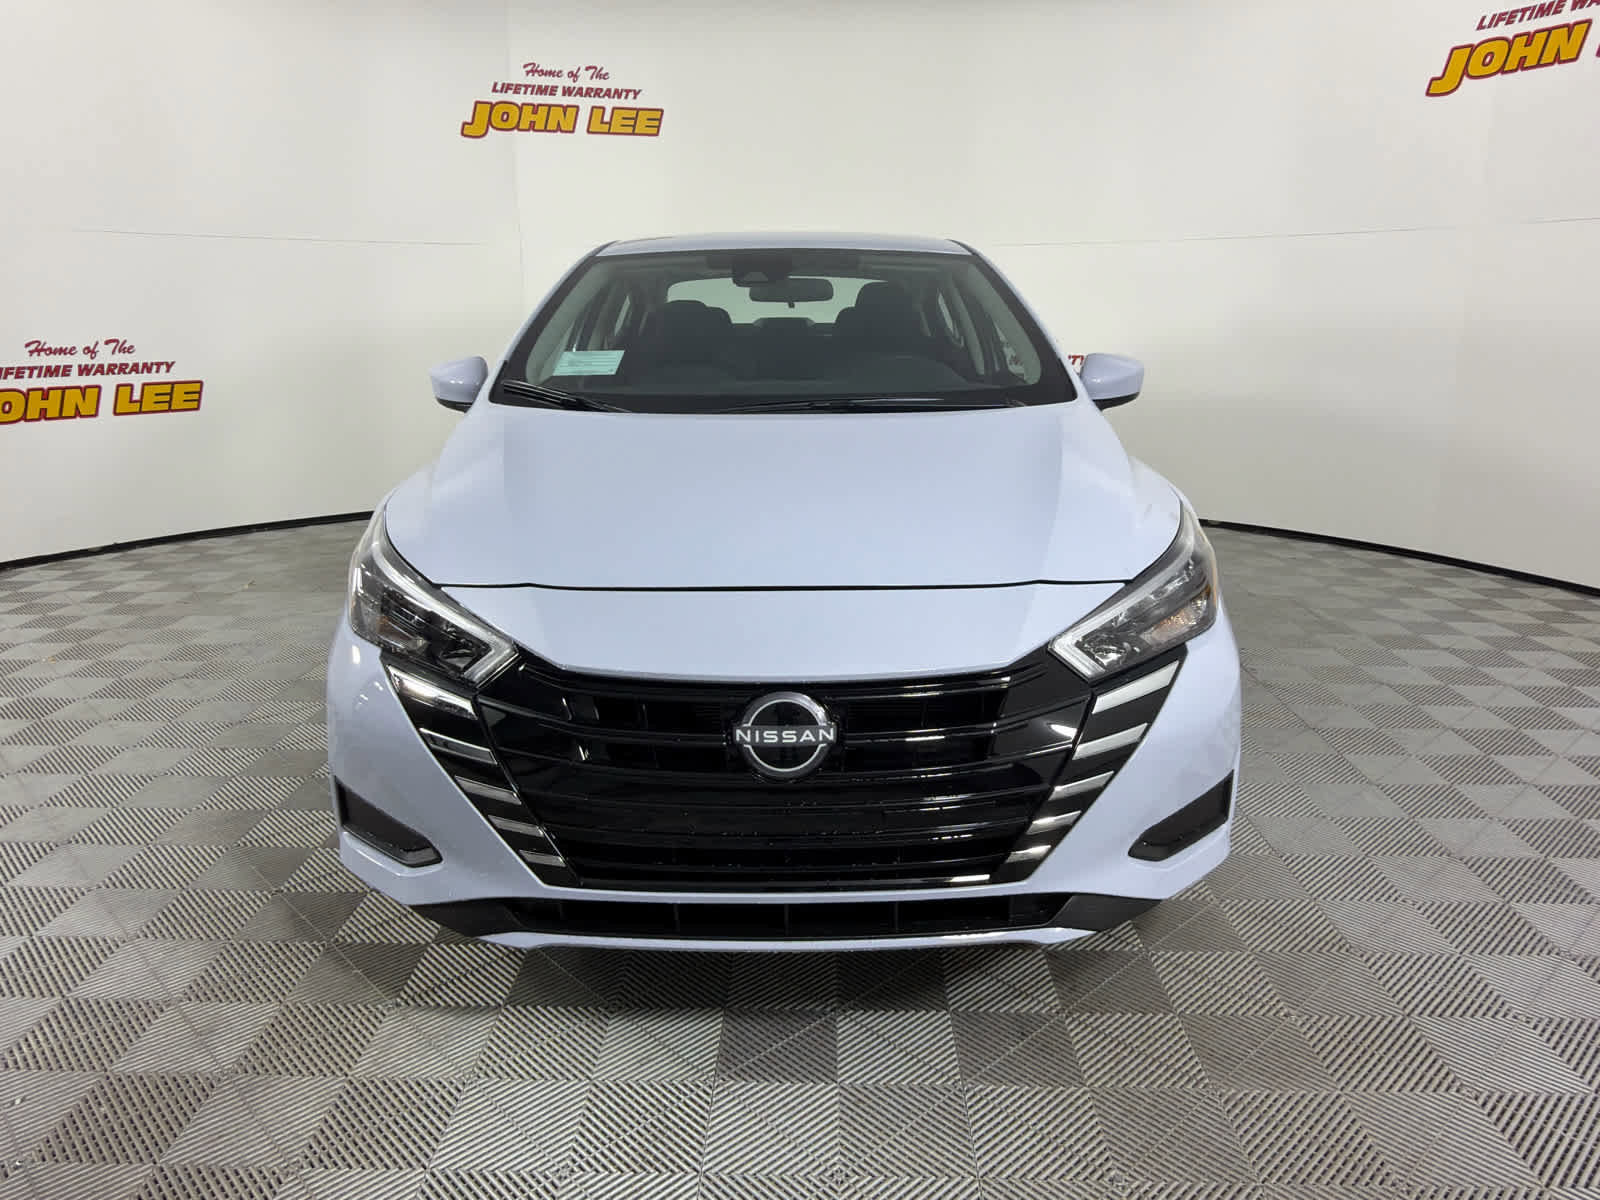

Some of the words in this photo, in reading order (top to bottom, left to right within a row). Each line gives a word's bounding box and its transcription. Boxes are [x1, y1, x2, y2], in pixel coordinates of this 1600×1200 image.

[1476, 0, 1567, 31] LIFETIME
[1425, 18, 1593, 97] JOHN
[523, 62, 563, 78] Home
[567, 67, 581, 82] of
[584, 65, 609, 80] The
[491, 82, 558, 96] LIFETIME
[561, 86, 641, 100] WARRANTY
[460, 100, 580, 139] JOHN
[586, 105, 664, 136] LEE
[24, 340, 77, 357] Home
[82, 341, 99, 359] of
[104, 338, 135, 354] The
[0, 364, 72, 380] IFETIME
[77, 361, 175, 377] WARRANTY
[0, 385, 102, 425] OHN
[113, 380, 203, 416] LEE
[735, 728, 834, 743] NISSAN
